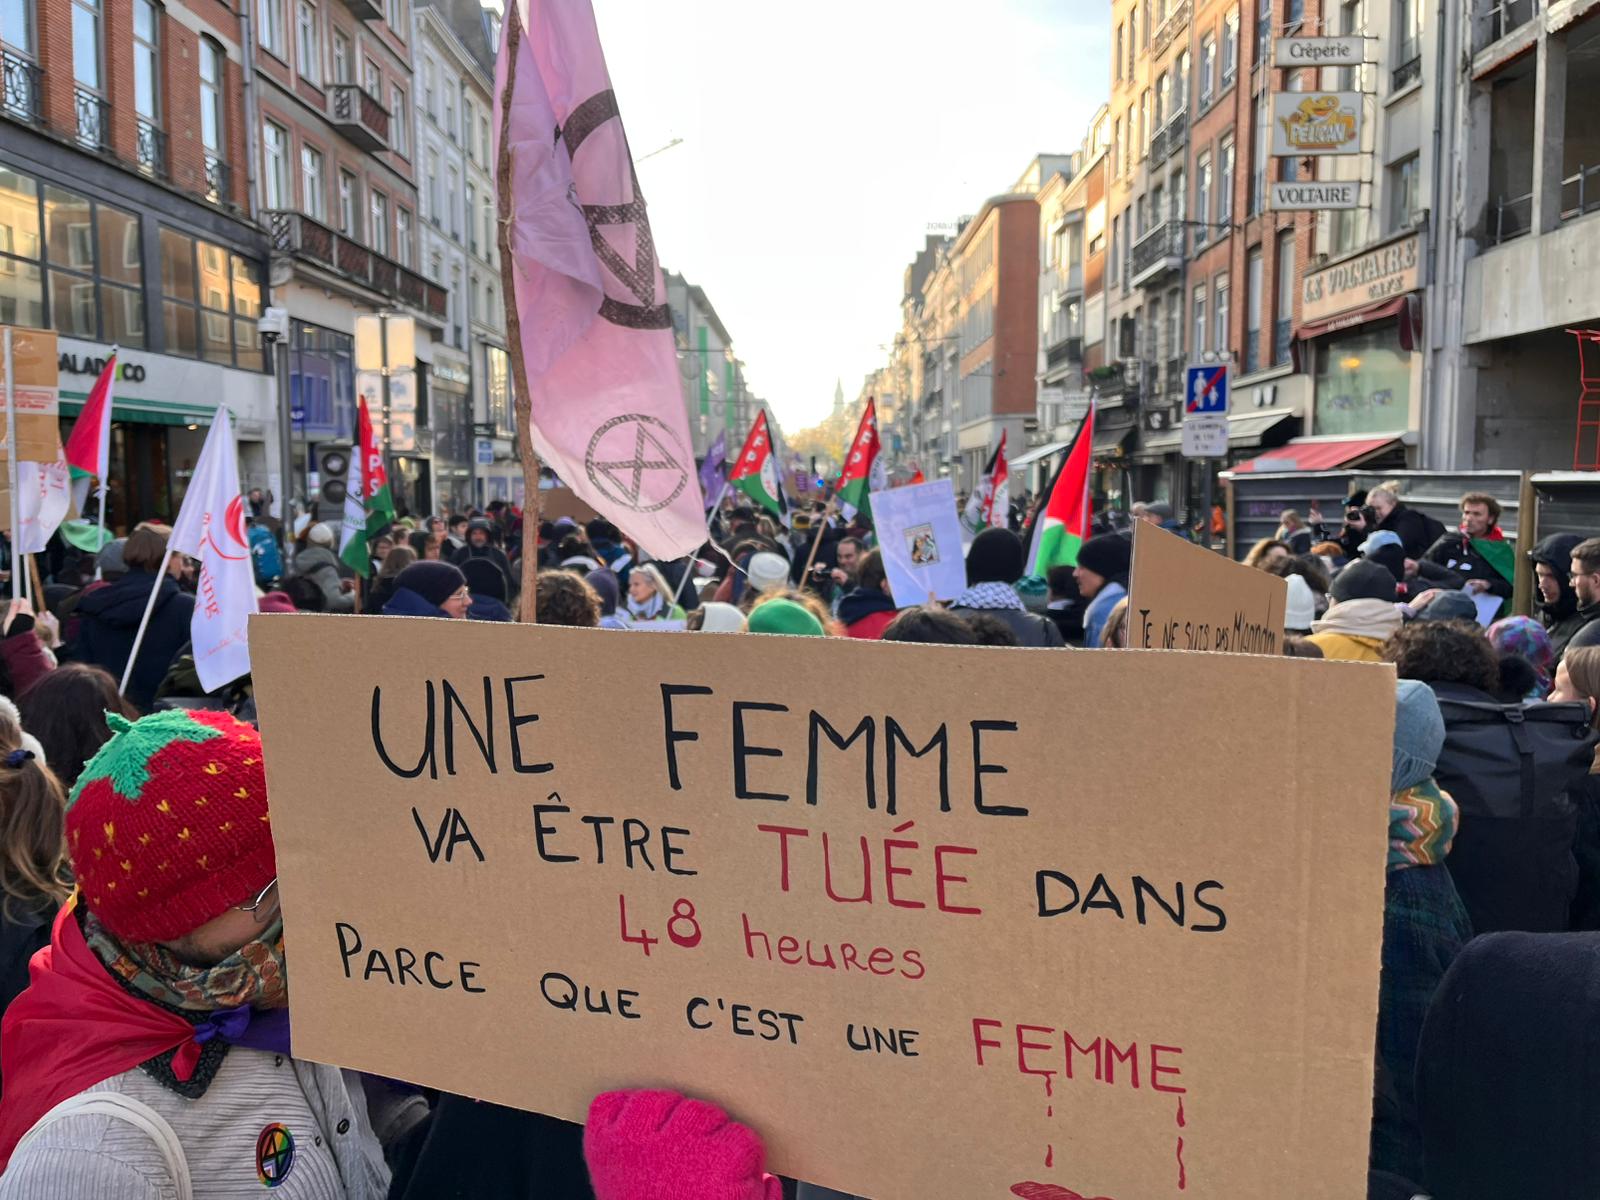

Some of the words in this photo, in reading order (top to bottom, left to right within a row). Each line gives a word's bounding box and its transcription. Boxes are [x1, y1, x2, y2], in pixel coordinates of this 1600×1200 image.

[1290, 42, 1350, 60] Crêperie
[1278, 187, 1351, 204] VOLTAIRE
[1327, 239, 1416, 296] VOLTAIRE
[371, 674, 554, 780] UNE
[660, 683, 1029, 817] FEMME
[411, 806, 485, 863] VA
[533, 791, 698, 876] ÊTRE
[757, 820, 982, 915] TUÉE
[1036, 869, 1227, 932] DANS
[619, 894, 701, 957] 48
[335, 922, 486, 993] PARCE
[540, 972, 641, 1019] QUE
[686, 996, 804, 1045] C'EST
[846, 1023, 920, 1057] UNE
[972, 1017, 1187, 1094] FEMME
